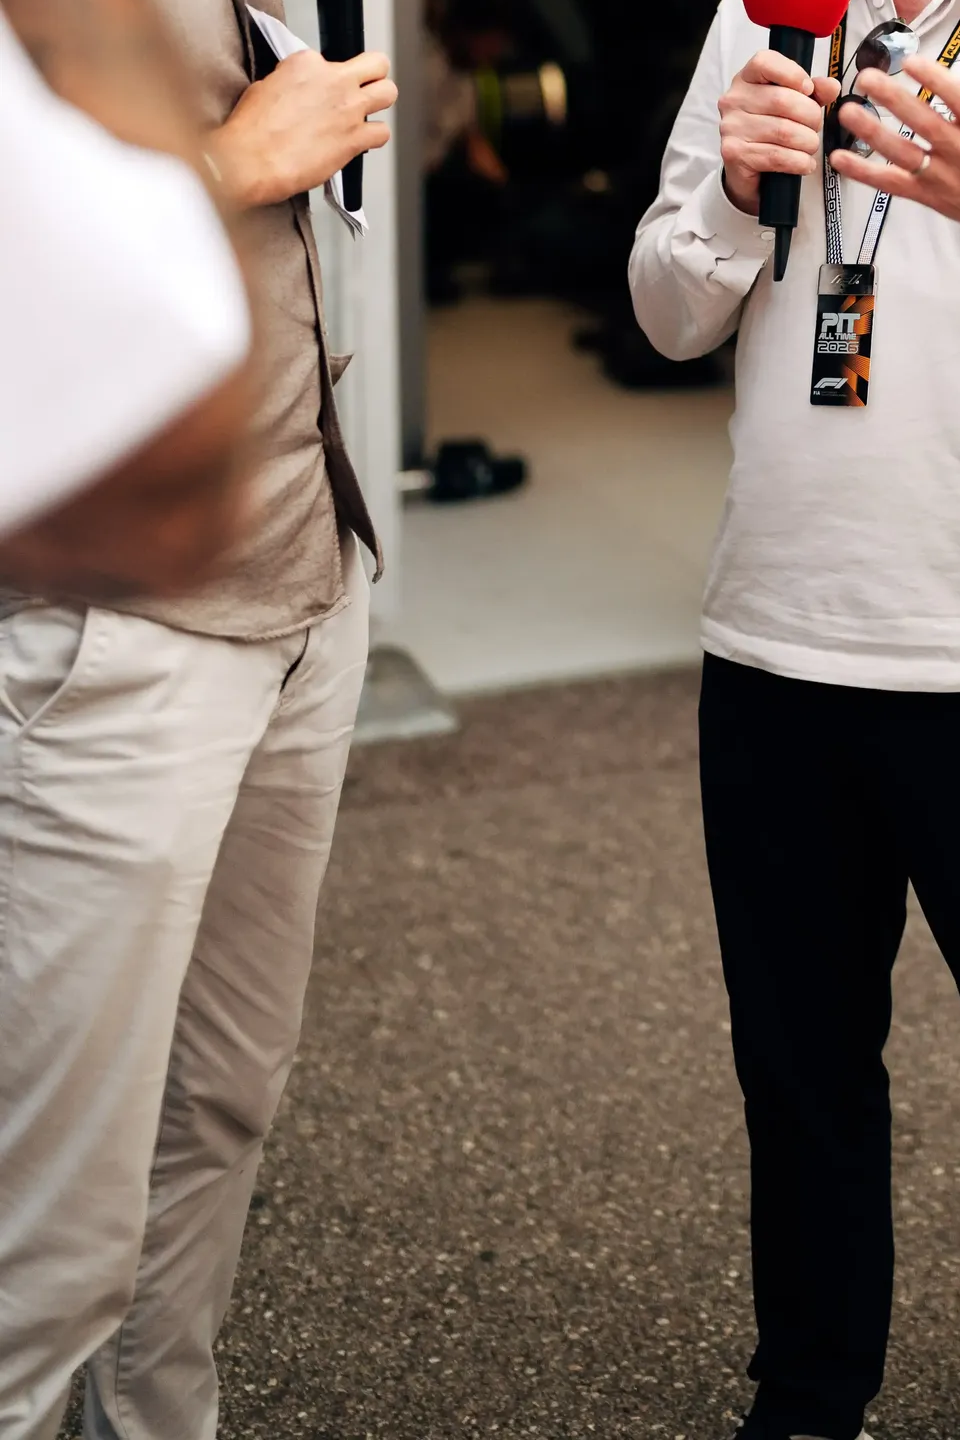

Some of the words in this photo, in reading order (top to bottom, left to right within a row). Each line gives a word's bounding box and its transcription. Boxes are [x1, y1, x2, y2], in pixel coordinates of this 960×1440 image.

[946, 41, 959, 56] ALL
[821, 312, 861, 333] PIT
[818, 332, 835, 341] ALL
[835, 332, 857, 341] TIME
[817, 340, 860, 354] 2026
